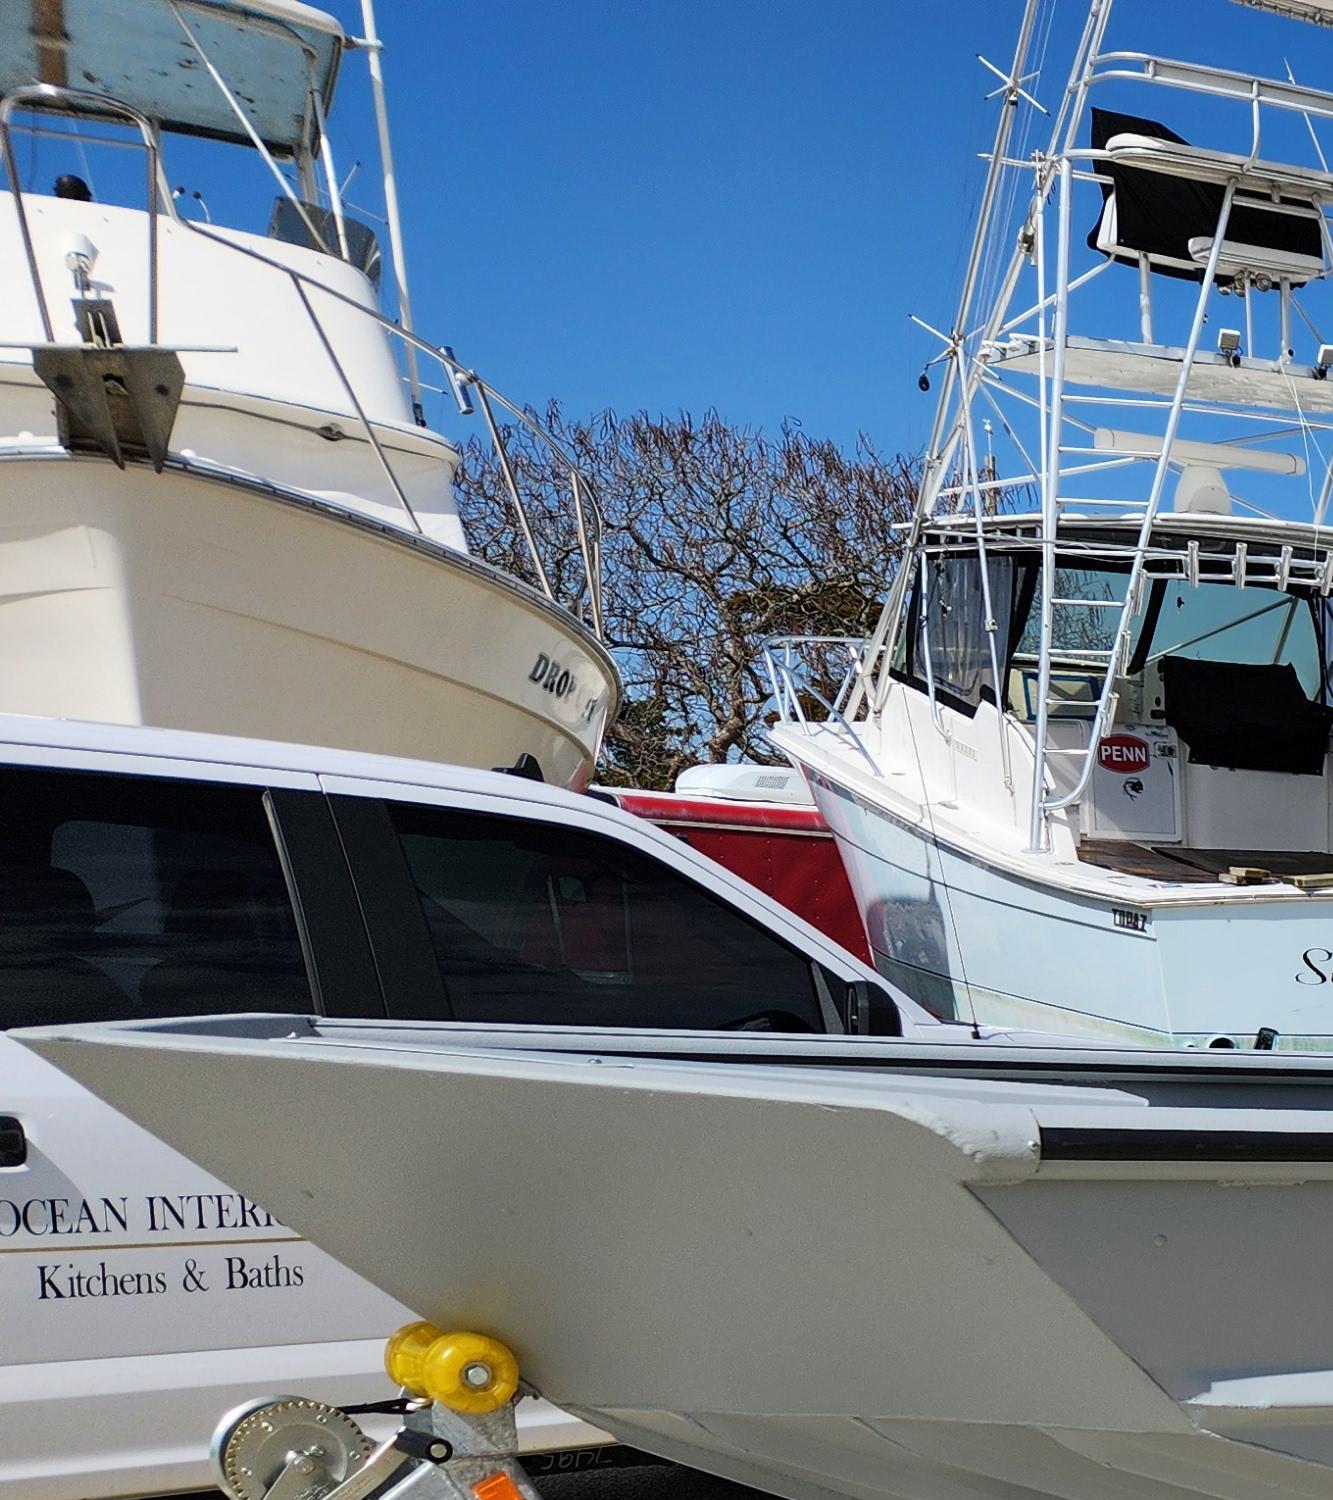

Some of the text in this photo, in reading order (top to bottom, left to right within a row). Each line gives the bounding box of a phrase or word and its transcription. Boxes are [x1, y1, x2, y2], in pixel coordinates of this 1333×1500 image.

[1101, 745, 1147, 763] PENN
[0, 1193, 286, 1237] OCEAN INTER
[37, 1254, 304, 1300] Kitchens & Baths
